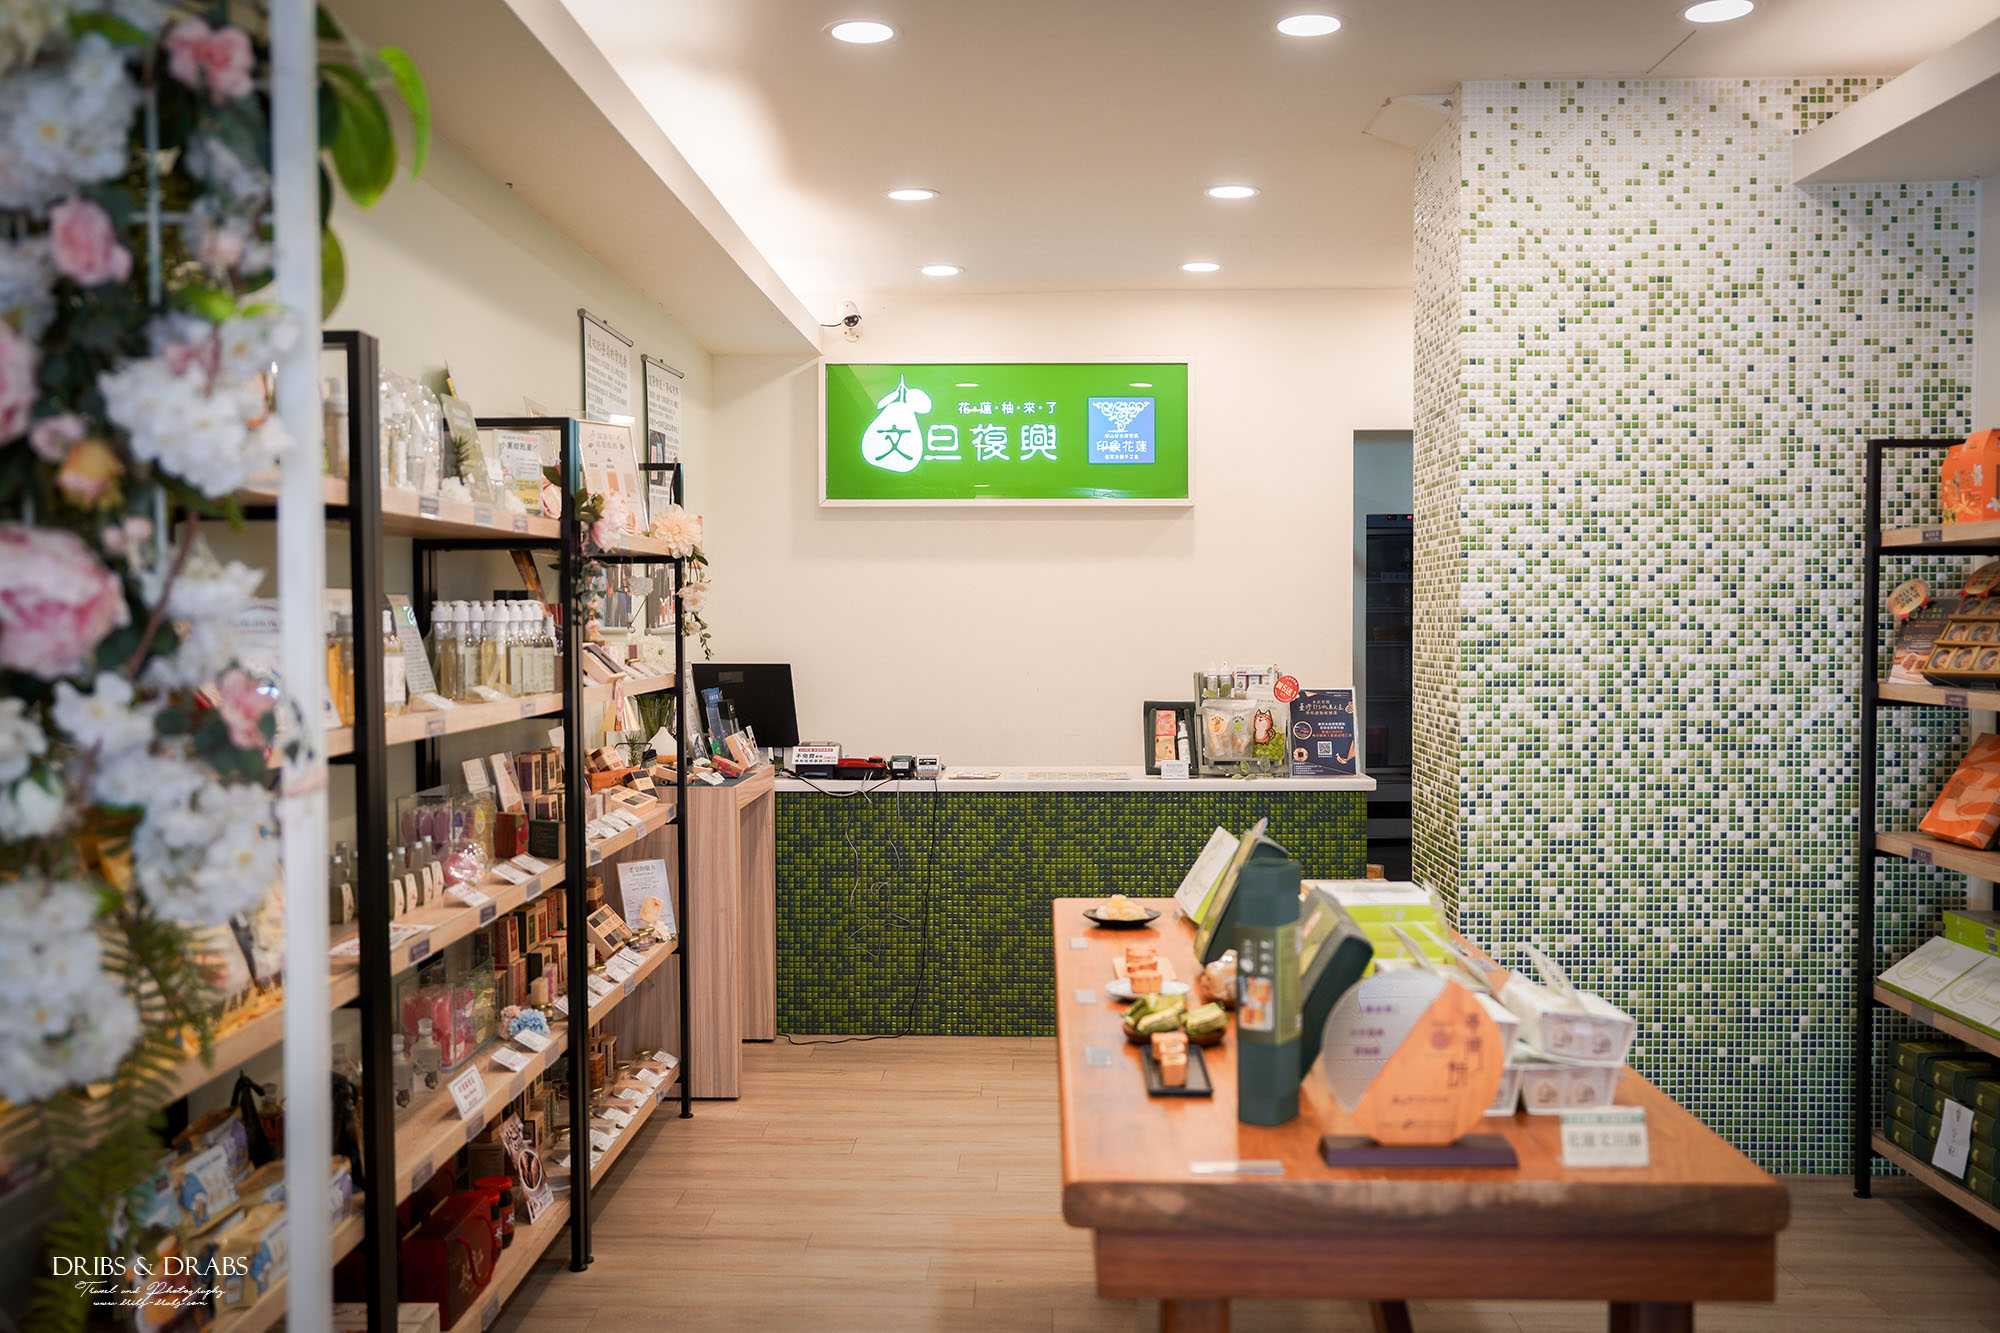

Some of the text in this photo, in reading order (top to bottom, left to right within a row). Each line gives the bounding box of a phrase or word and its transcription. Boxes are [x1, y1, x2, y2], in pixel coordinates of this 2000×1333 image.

[875, 423, 1058, 462] 文旦復興
[1096, 439, 1147, 453] 印象花蓮
